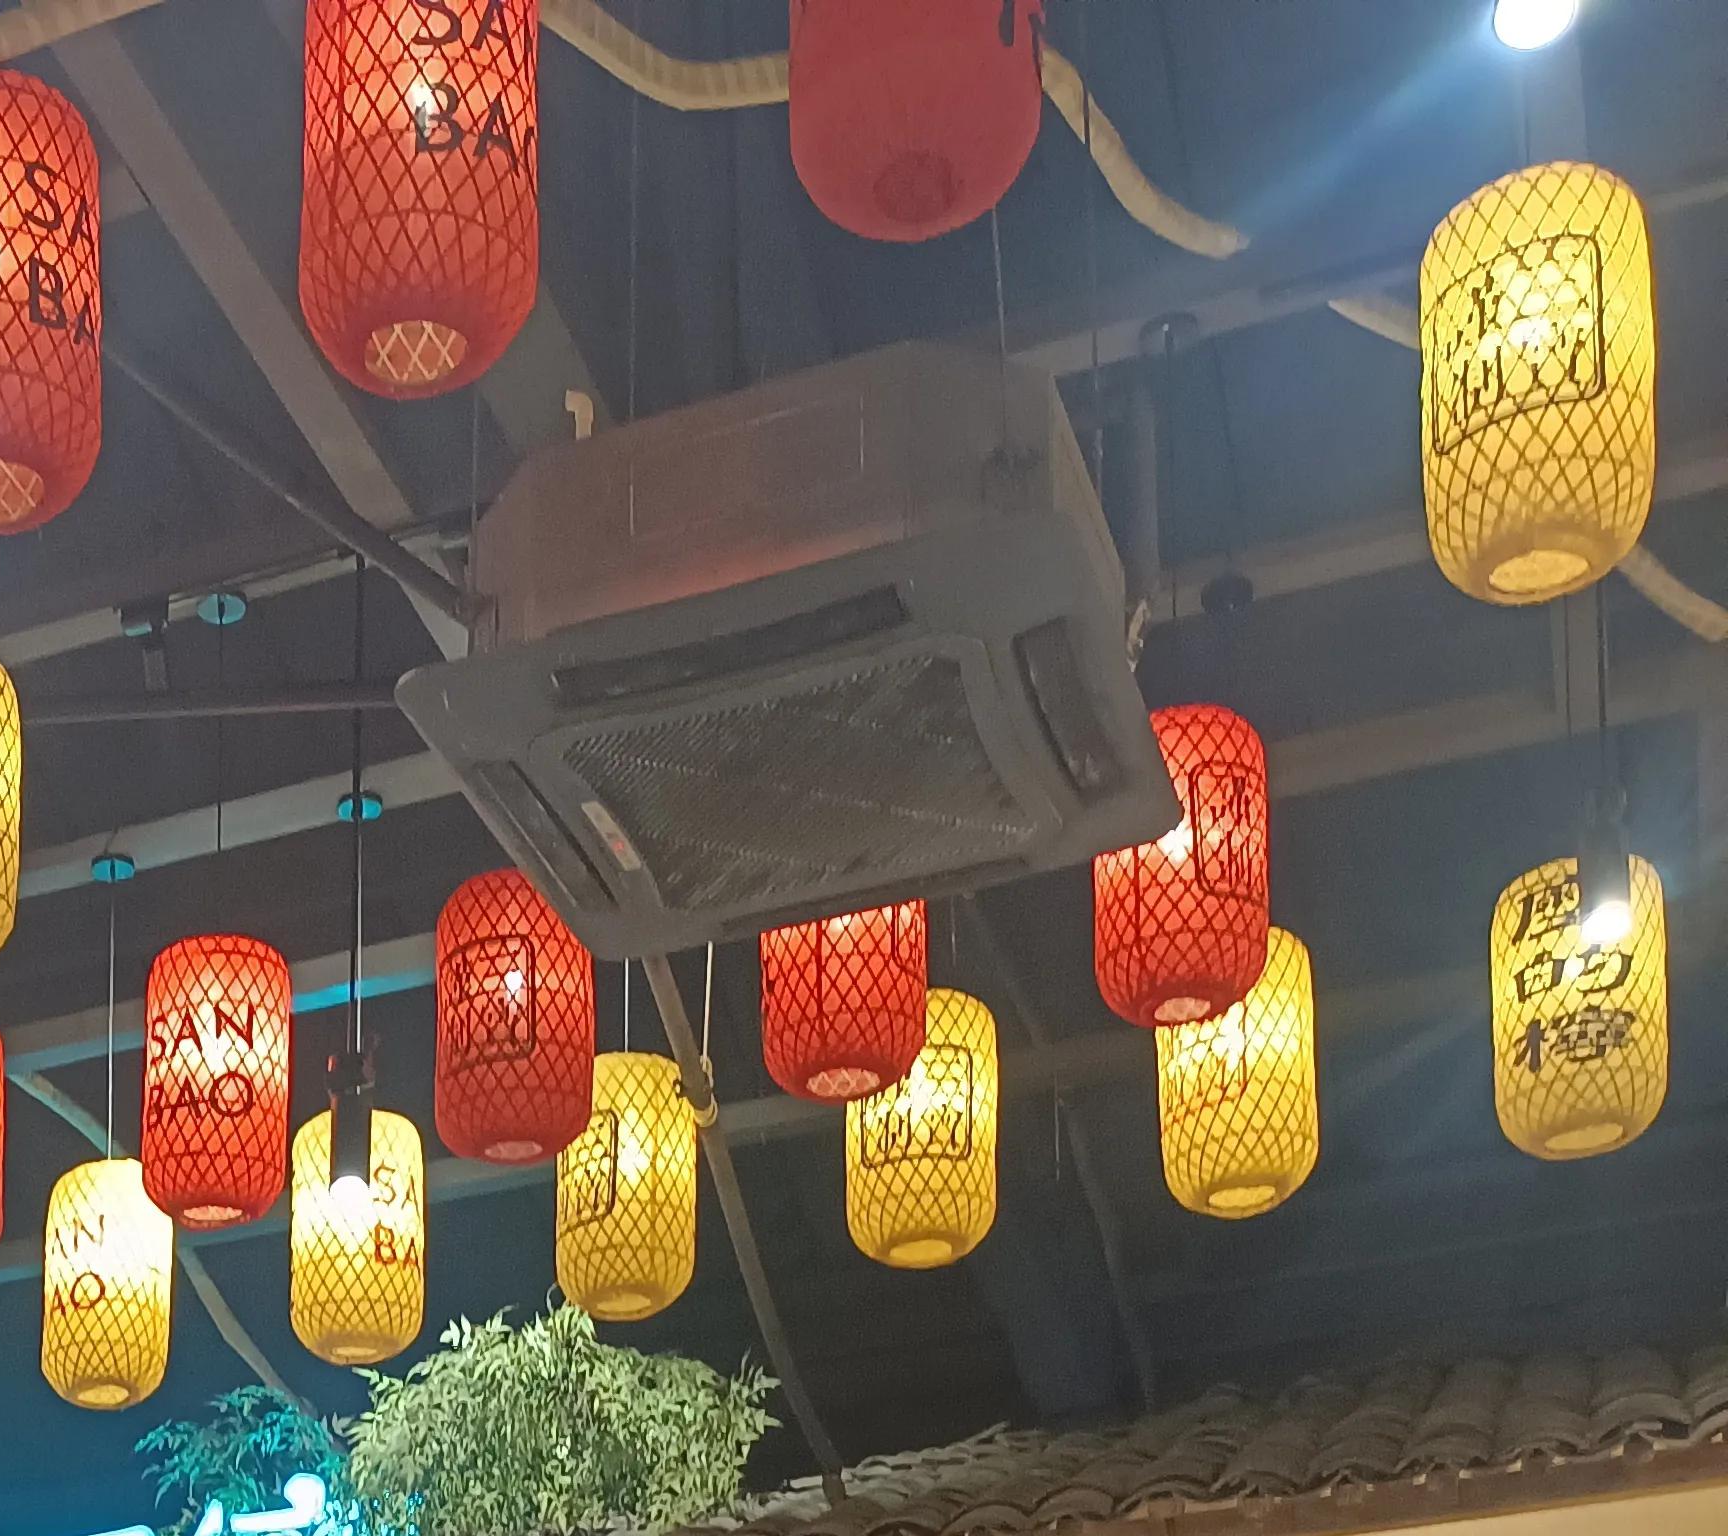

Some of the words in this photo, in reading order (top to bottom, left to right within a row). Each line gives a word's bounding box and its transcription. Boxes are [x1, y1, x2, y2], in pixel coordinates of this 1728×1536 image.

[411, 0, 532, 82] SA
[415, 82, 535, 178] BA
[150, 1000, 257, 1068] SAN
